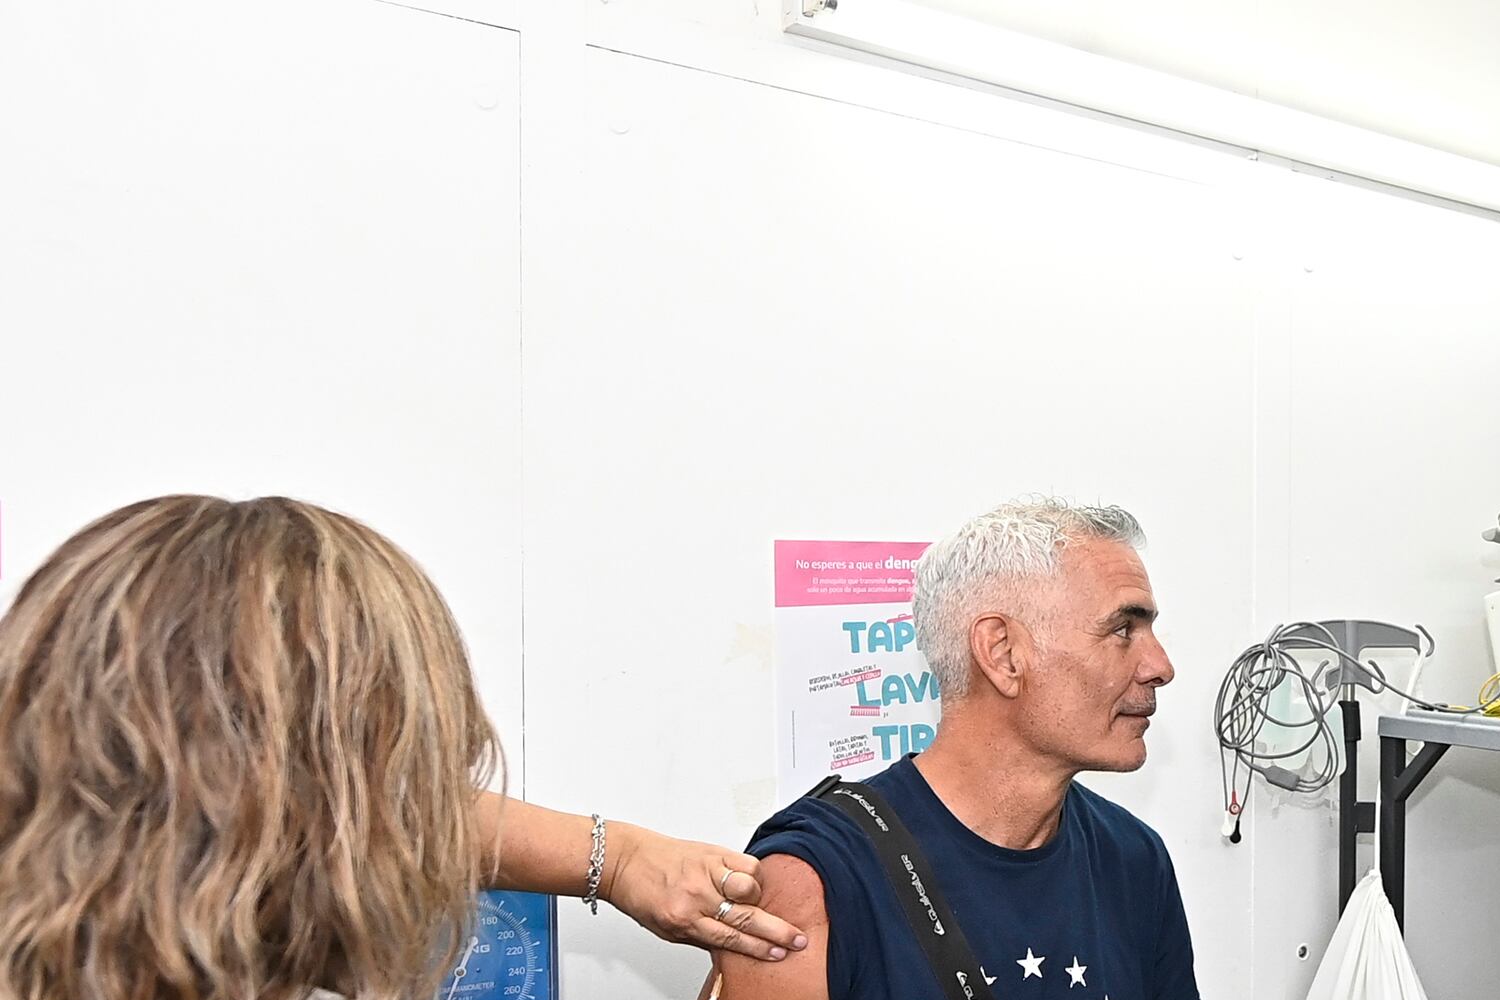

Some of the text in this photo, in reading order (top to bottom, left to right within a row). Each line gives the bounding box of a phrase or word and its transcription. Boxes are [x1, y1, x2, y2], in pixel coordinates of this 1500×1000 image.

[796, 560, 809, 569] No
[811, 561, 846, 572] esperes
[855, 562, 873, 571] que
[875, 560, 883, 569] el
[872, 723, 940, 760] TIR
[482, 916, 498, 925] 180
[497, 930, 515, 940] 200
[505, 946, 523, 956] 220
[508, 966, 525, 977] 240
[503, 985, 521, 995] 260
